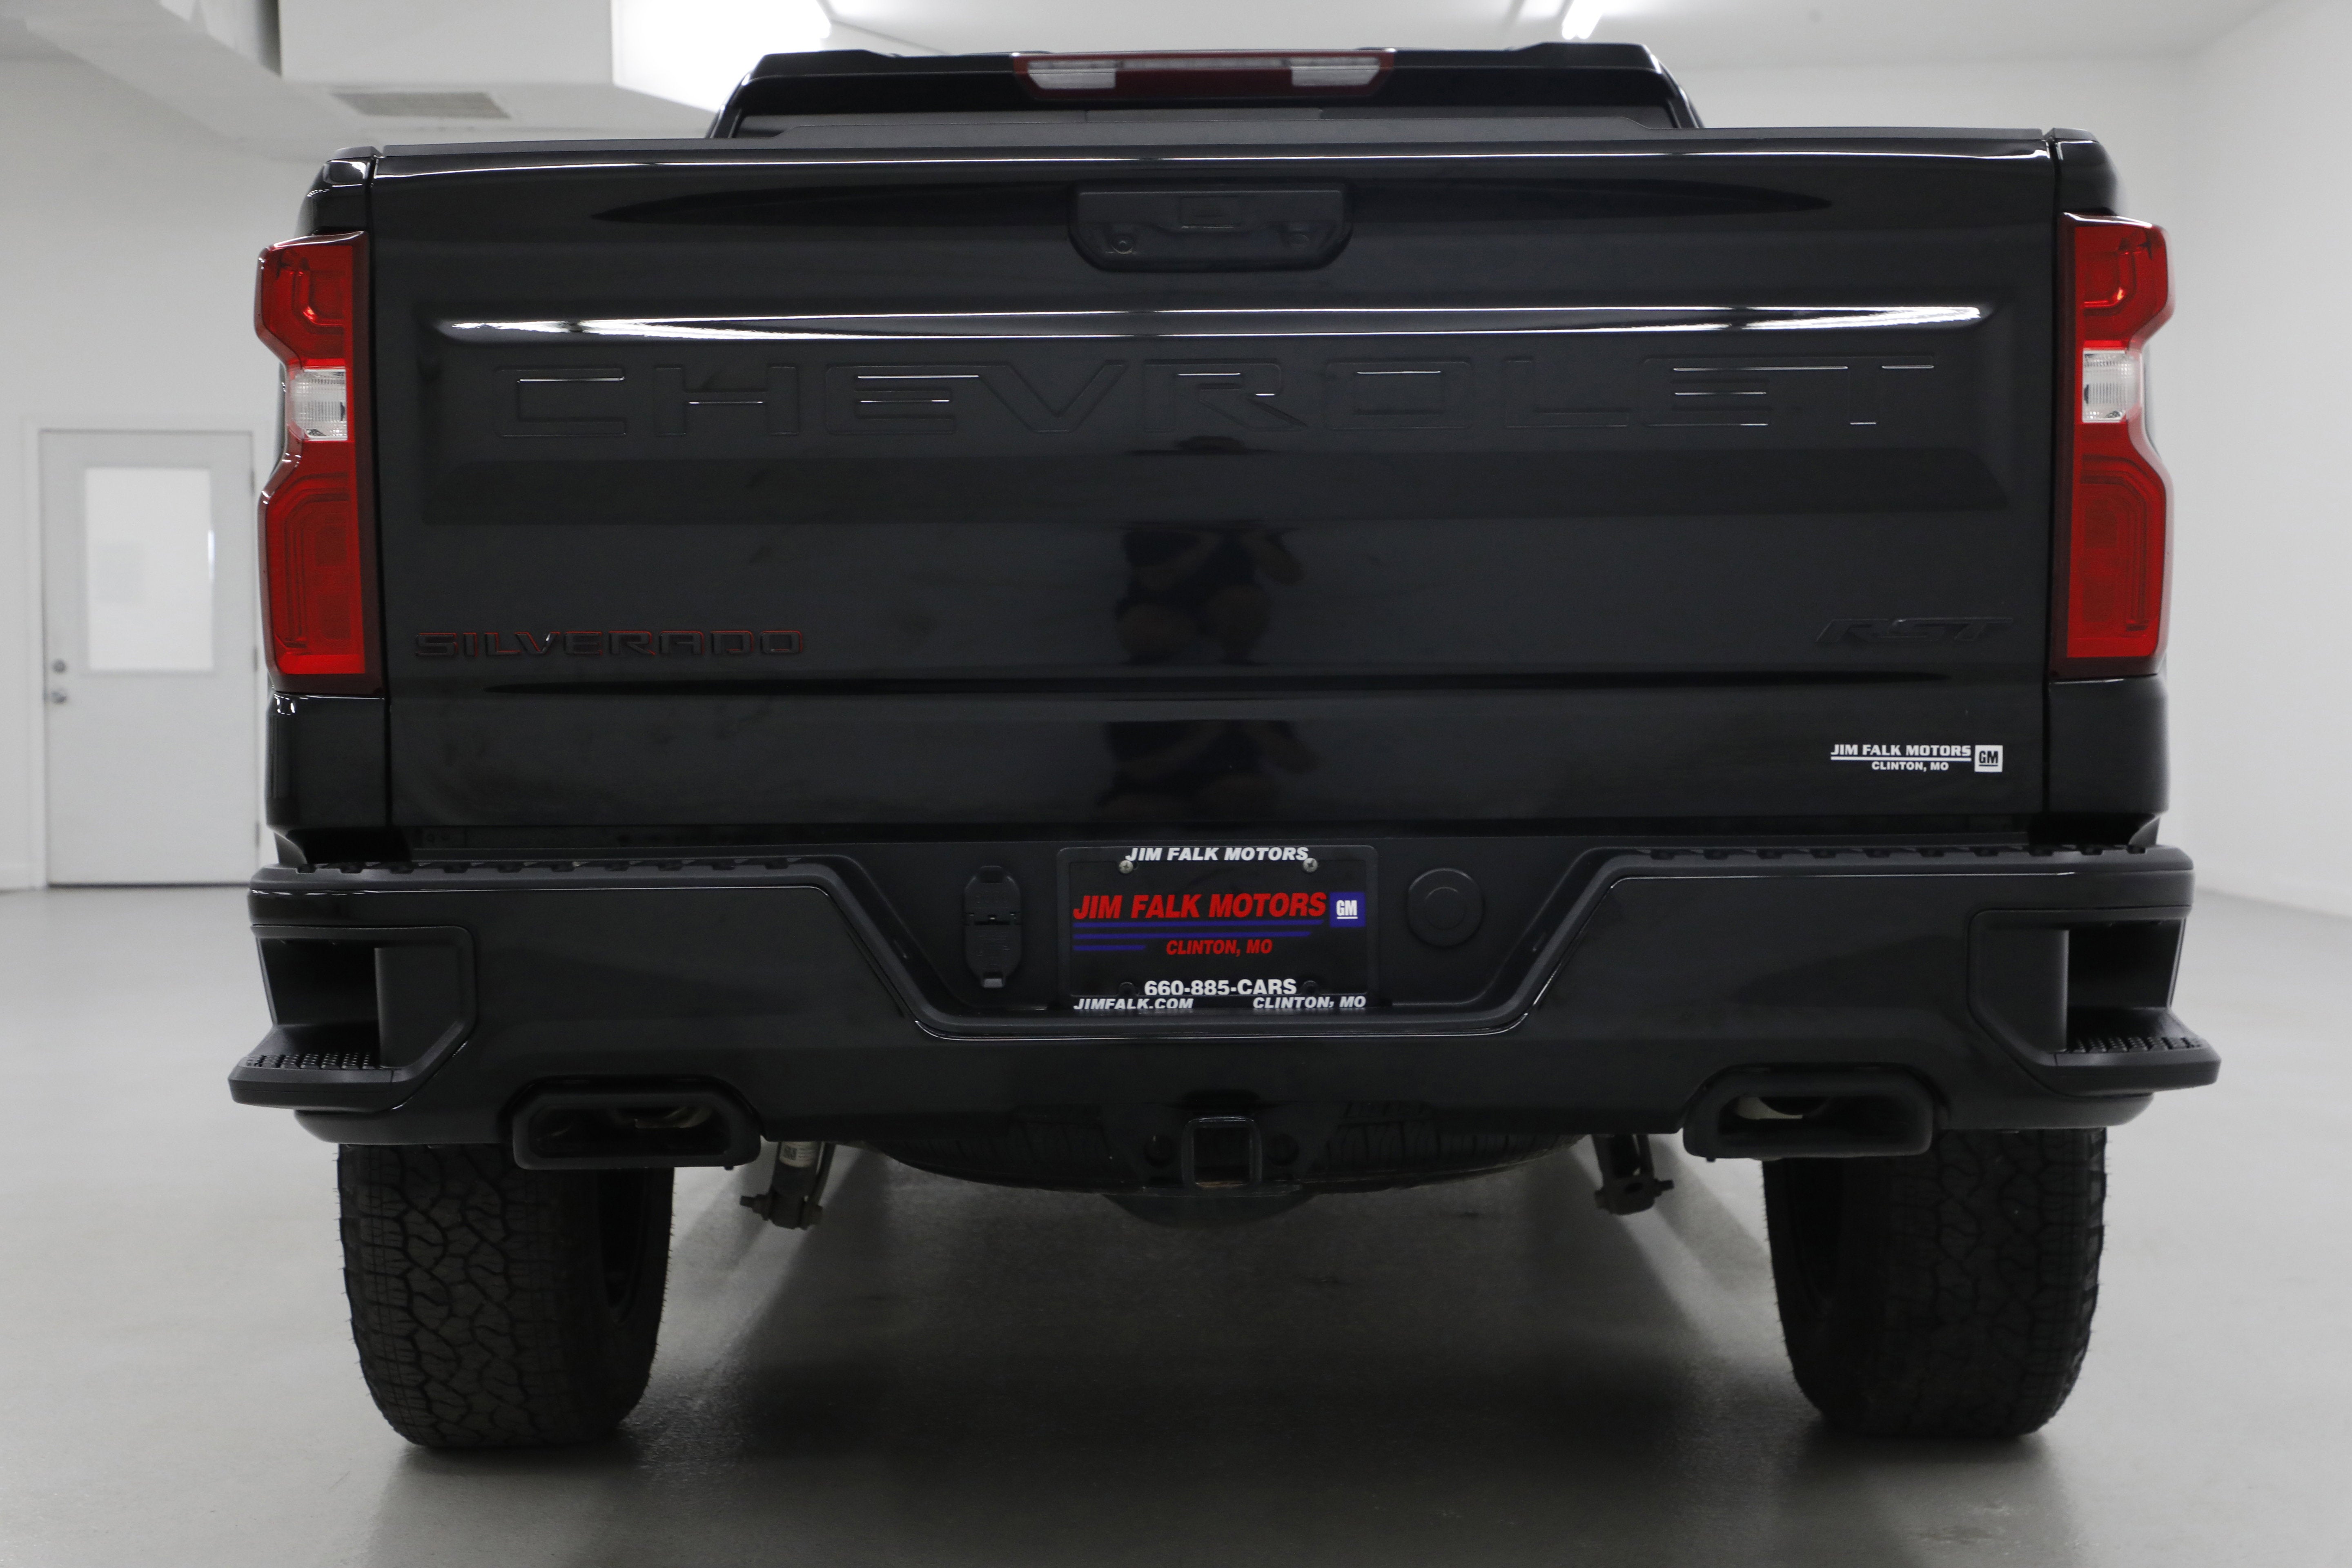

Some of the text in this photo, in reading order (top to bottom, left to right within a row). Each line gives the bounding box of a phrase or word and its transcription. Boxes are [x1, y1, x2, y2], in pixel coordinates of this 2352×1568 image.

[494, 353, 1936, 437] CHEVROLET
[415, 630, 804, 658] SILVERADO
[1830, 744, 1971, 757] JIM FALK MOTORS
[1979, 751, 1998, 764] GM
[1871, 761, 1949, 772] CLINTON, MO
[1125, 846, 1309, 861] JIM FALK MOTORS
[1072, 892, 1327, 920] JIM FALK MOTORS
[1336, 900, 1358, 916] GM
[1166, 939, 1273, 957] CLINTON, MO
[1144, 979, 1297, 996] 660-885-CARS
[1073, 998, 1194, 1010] JIMFALK.COM
[1252, 996, 1367, 1009] CLINTON, MO
